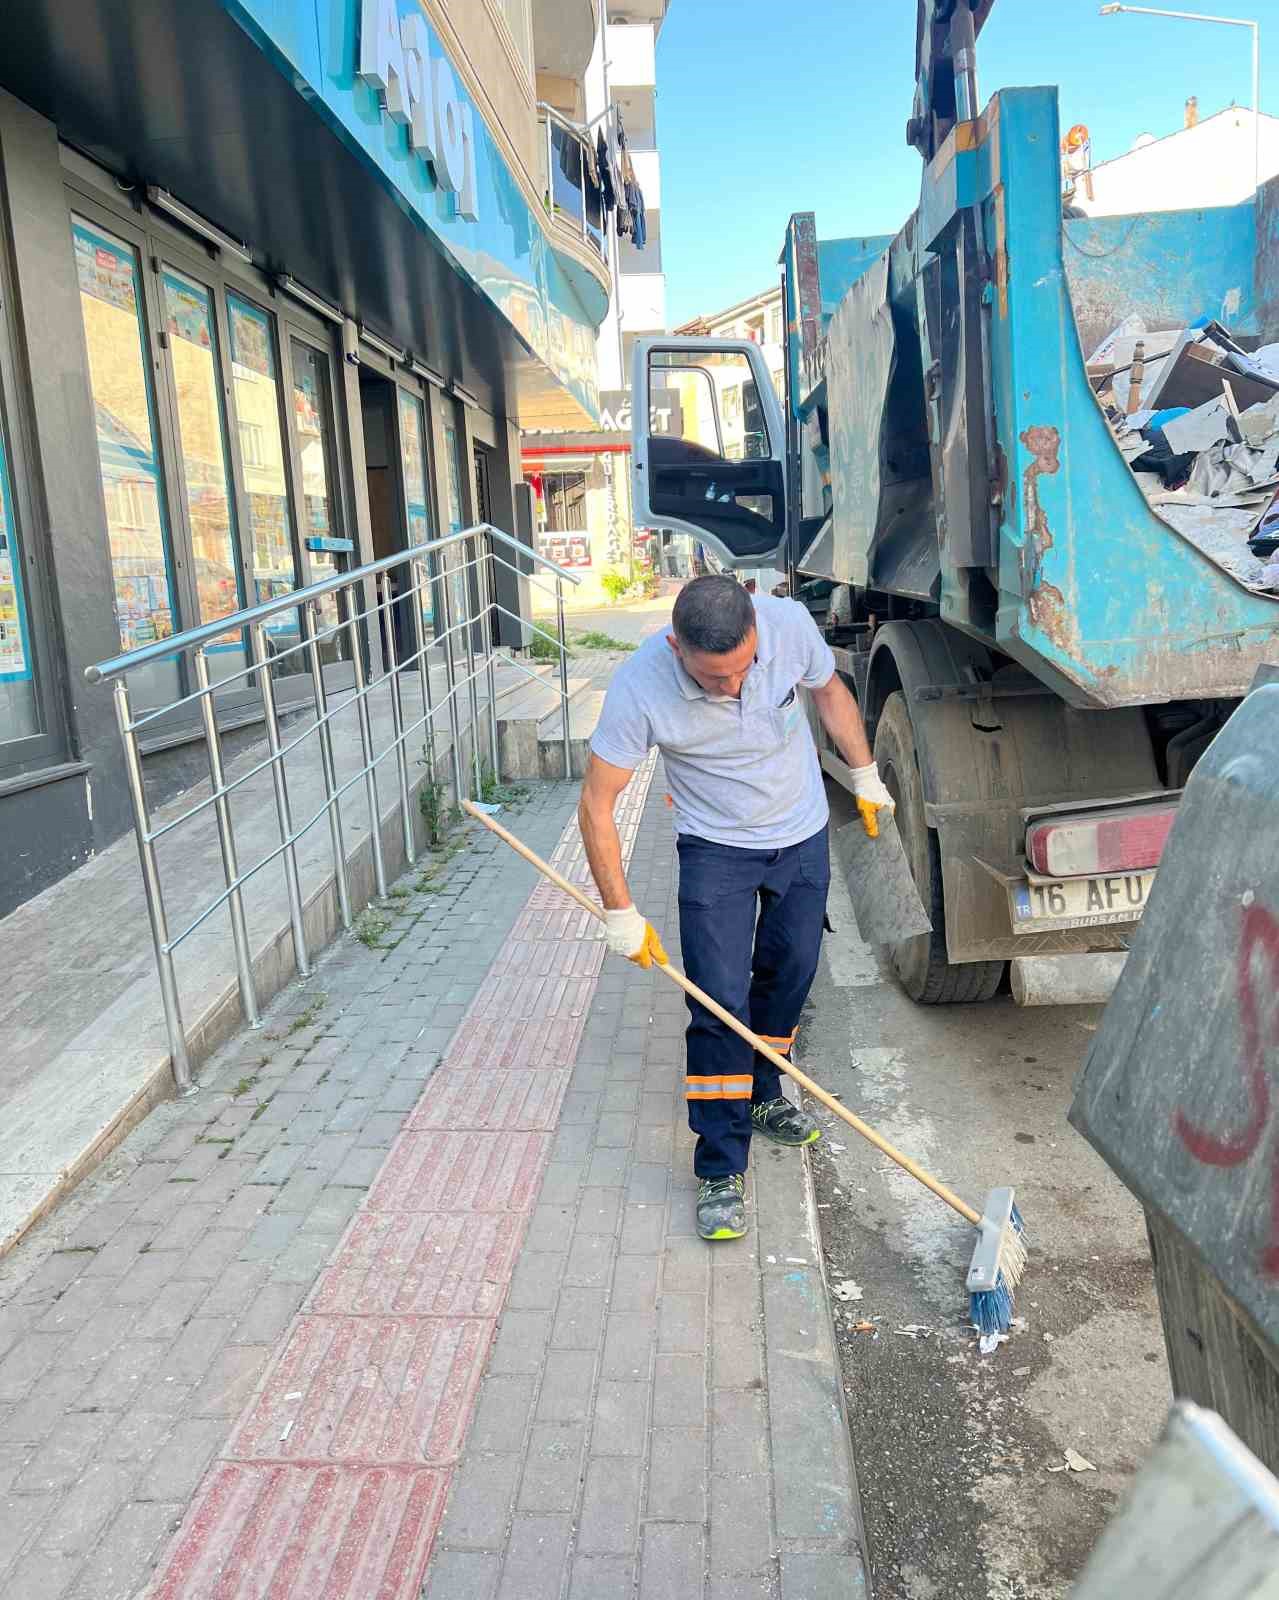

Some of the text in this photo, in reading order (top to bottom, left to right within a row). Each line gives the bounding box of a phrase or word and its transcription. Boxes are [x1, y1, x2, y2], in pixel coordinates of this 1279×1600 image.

[1016, 876, 1142, 915] TR 16 AFU
